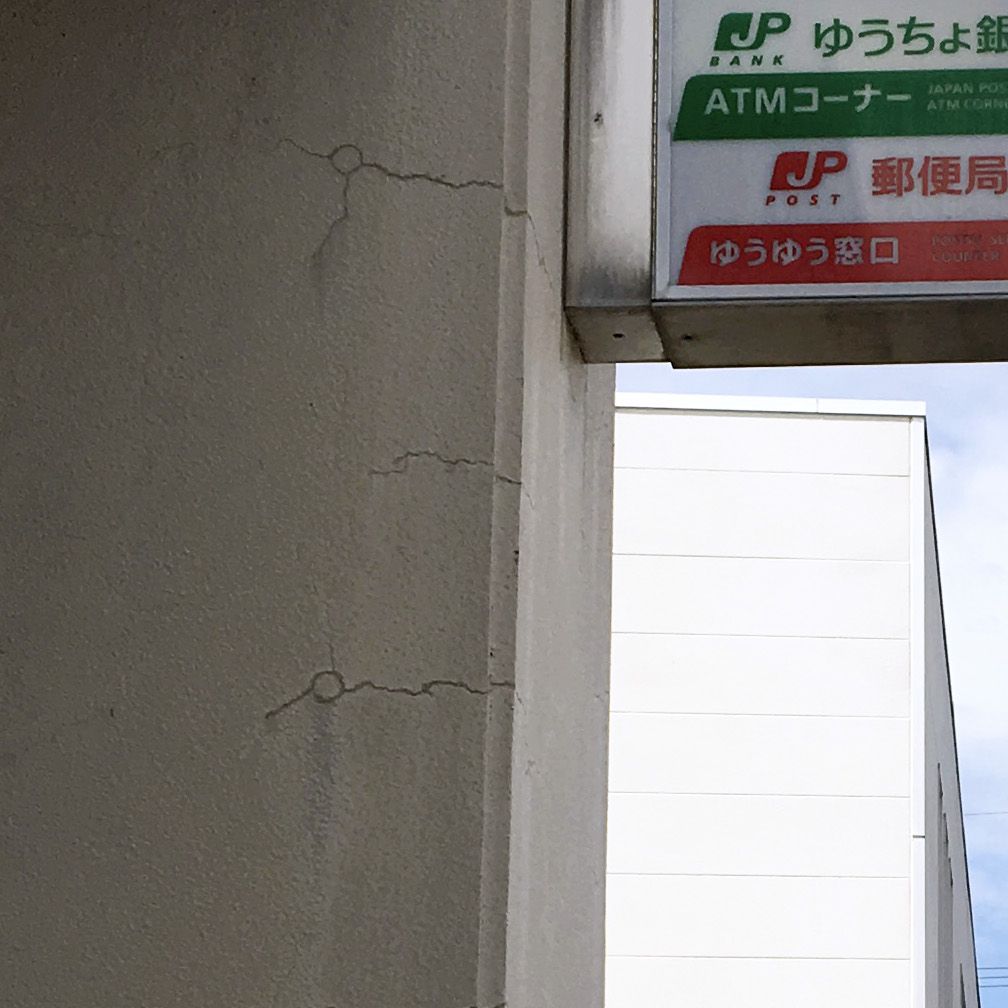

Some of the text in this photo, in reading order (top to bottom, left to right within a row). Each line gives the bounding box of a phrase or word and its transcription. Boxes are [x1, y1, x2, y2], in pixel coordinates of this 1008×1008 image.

[713, 12, 792, 52] JP
[709, 54, 784, 67] BANK
[704, 83, 912, 115] ATMコーナー
[928, 82, 974, 95] JAPAN
[926, 98, 960, 111] ATM
[769, 150, 1008, 197] JP 郵便局
[765, 194, 841, 206] POST
[710, 236, 899, 267] ゆうゆう窓口
